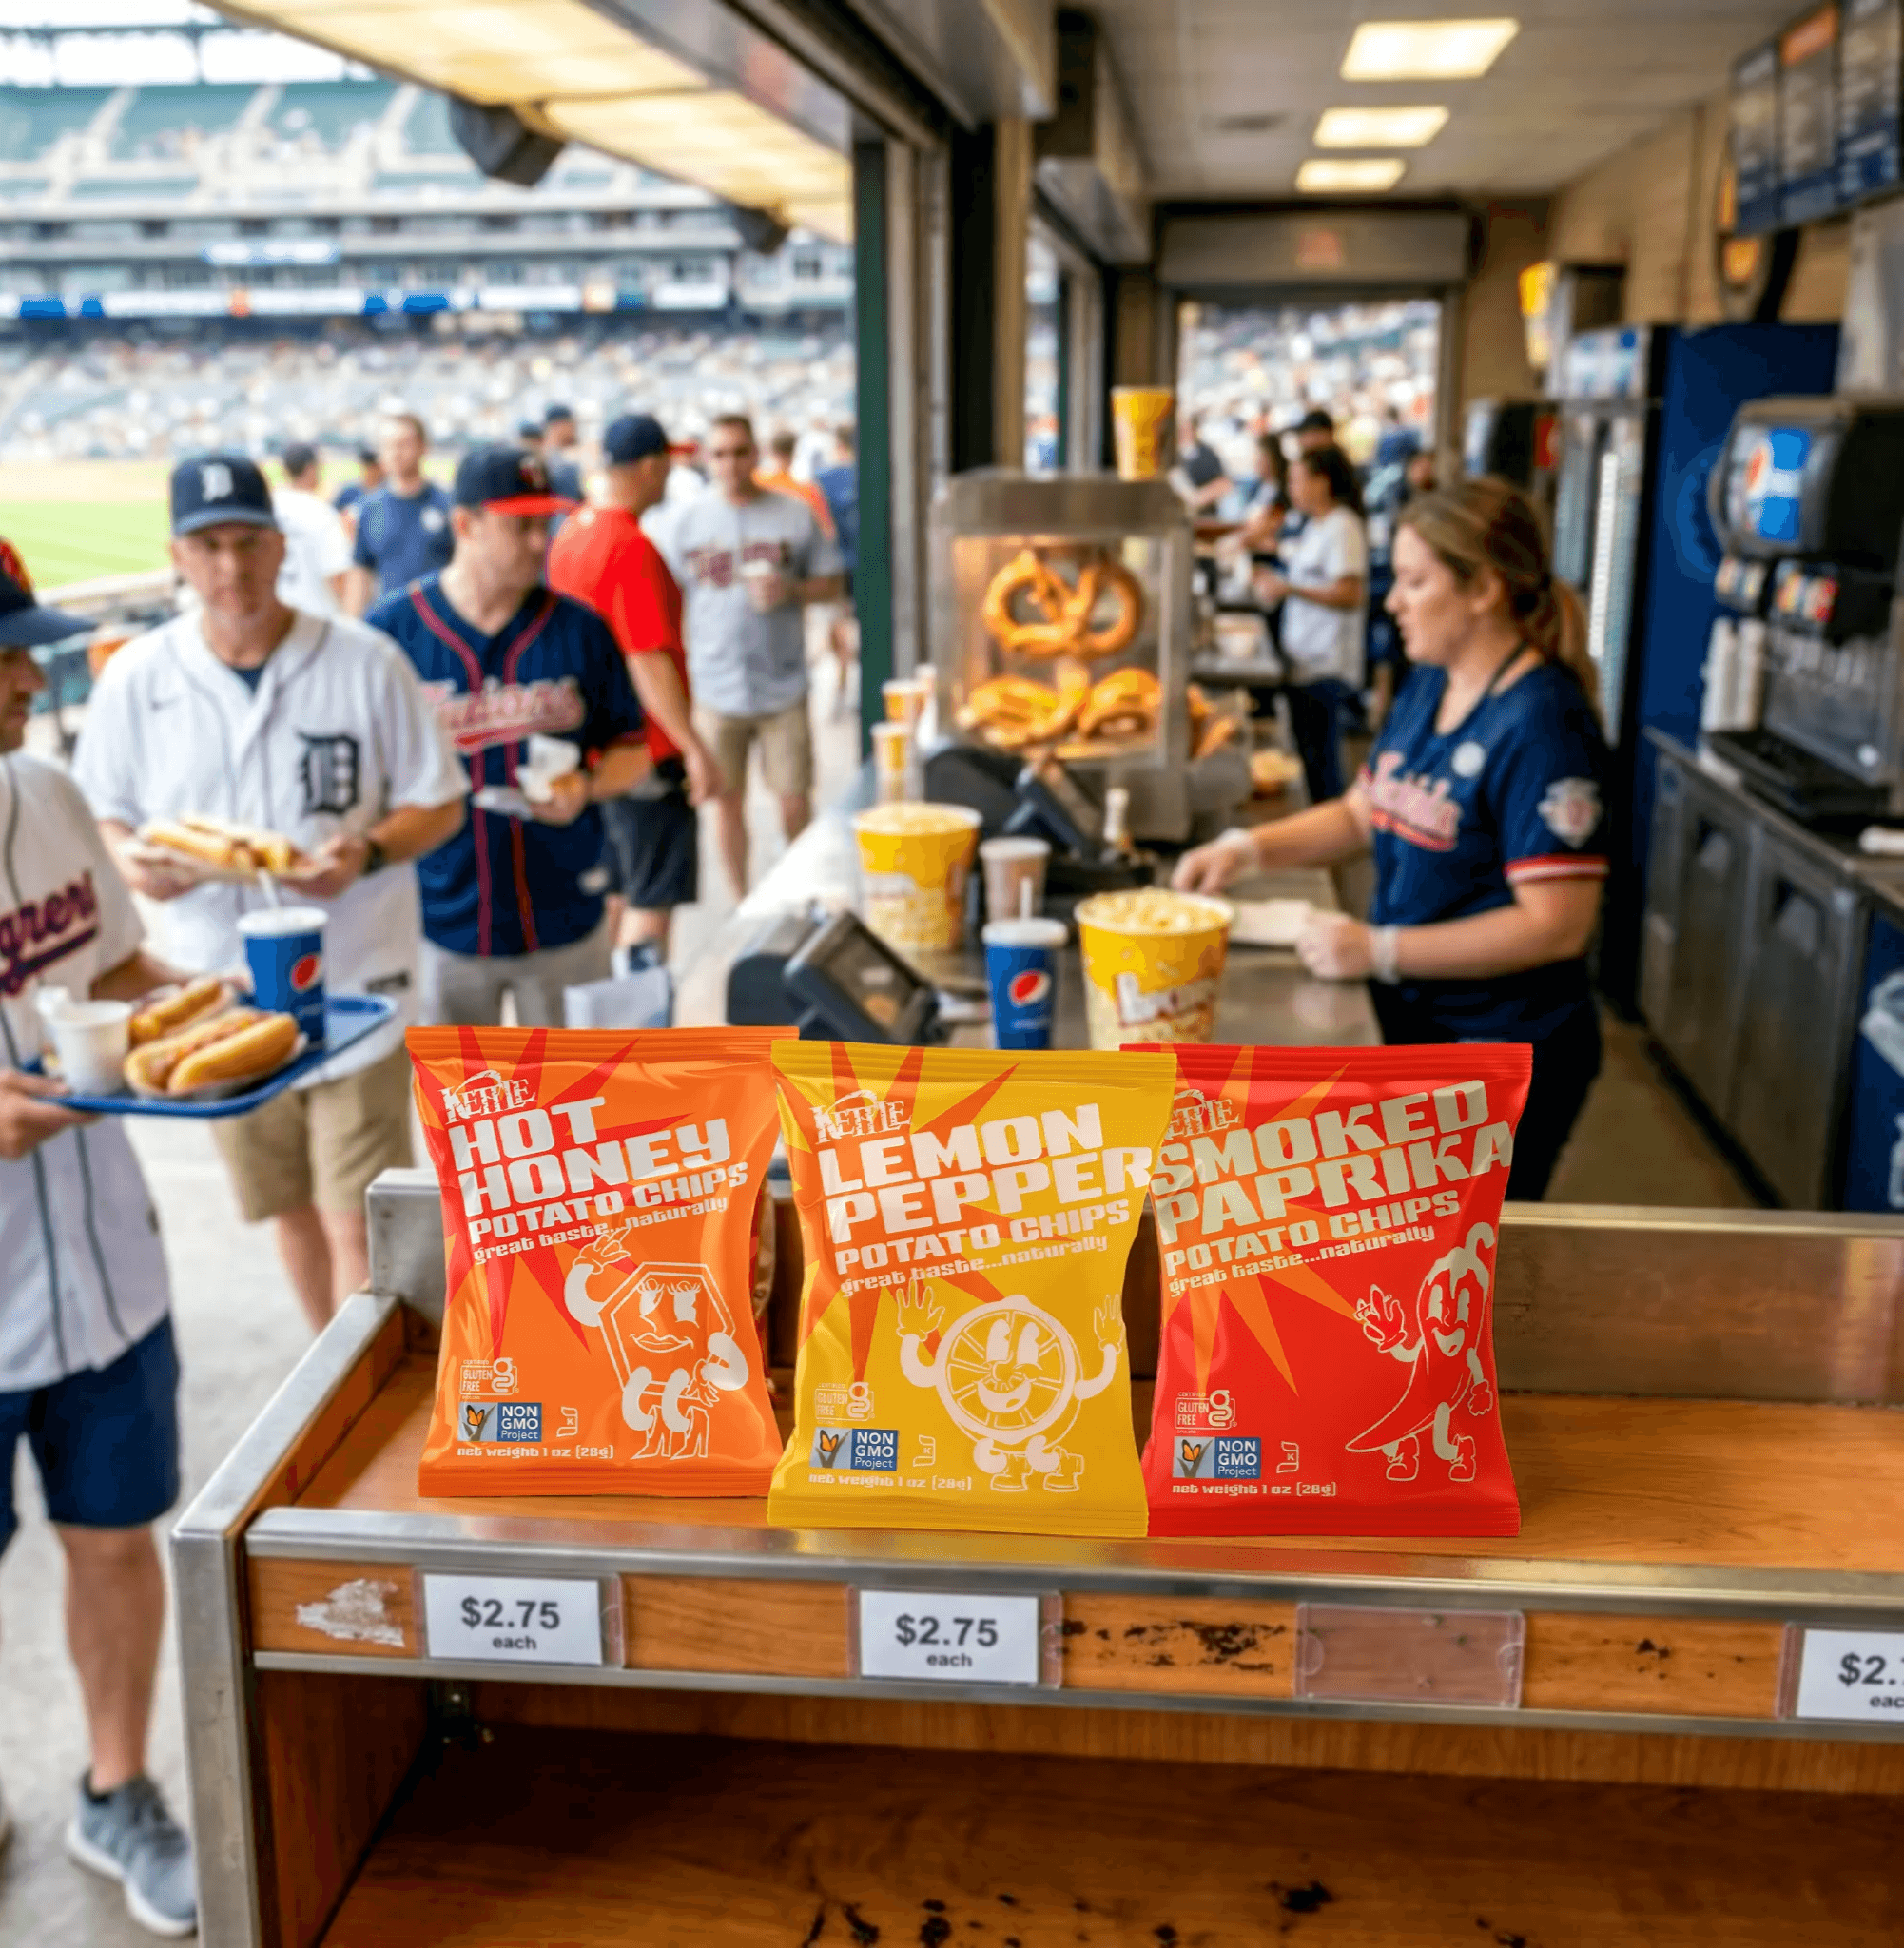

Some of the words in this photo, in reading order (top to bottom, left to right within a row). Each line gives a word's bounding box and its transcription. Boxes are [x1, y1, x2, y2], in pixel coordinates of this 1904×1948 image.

[438, 1069, 535, 1124] KETTLE
[810, 1089, 912, 1145] KETTLE
[1164, 1089, 1241, 1140] ETTLE
[448, 1097, 606, 1171] HOT
[1150, 1080, 1489, 1196] SMOKED
[818, 1103, 1103, 1196] LEMON
[458, 1118, 731, 1217] HONEY
[1155, 1121, 1514, 1245] PAPRIKA
[468, 1191, 625, 1244] POTATO
[632, 1161, 748, 1209] CHIPS
[826, 1146, 1153, 1244] PEPPER
[835, 1223, 1000, 1275] POTATO
[1010, 1198, 1130, 1243] CHIPS
[1164, 1219, 1320, 1276] POTATO
[1329, 1190, 1461, 1239] CHIPS
[474, 1238, 534, 1265] great
[840, 1272, 906, 1297] great
[1168, 1268, 1228, 1297] great
[463, 1370, 493, 1380] GLUTEN
[462, 1381, 480, 1392] FREE
[502, 1406, 537, 1417] NON
[1178, 1402, 1210, 1413] GLUTEN
[501, 1418, 539, 1430] GMO
[1177, 1414, 1196, 1426] FREE
[501, 1431, 538, 1441] Project
[857, 1432, 894, 1444] NON
[457, 1448, 482, 1457] net
[486, 1446, 539, 1459] weight
[552, 1449, 571, 1457] oz
[856, 1445, 894, 1458] GMO
[1218, 1441, 1256, 1452] NON
[855, 1457, 893, 1470] Project
[1218, 1453, 1257, 1466] GMO
[1218, 1466, 1256, 1477] Project
[808, 1473, 835, 1484] net
[839, 1474, 894, 1488] weight
[906, 1478, 926, 1488] oz
[1172, 1484, 1198, 1494] net
[1202, 1483, 1258, 1496] weight
[1272, 1486, 1292, 1494] oz
[461, 1596, 560, 1630] $2.75
[895, 1613, 999, 1647] $2.75
[492, 1636, 537, 1650] each
[926, 1653, 973, 1667] each
[1838, 1652, 1904, 1687] $2.
[1869, 1696, 1904, 1709] eac
